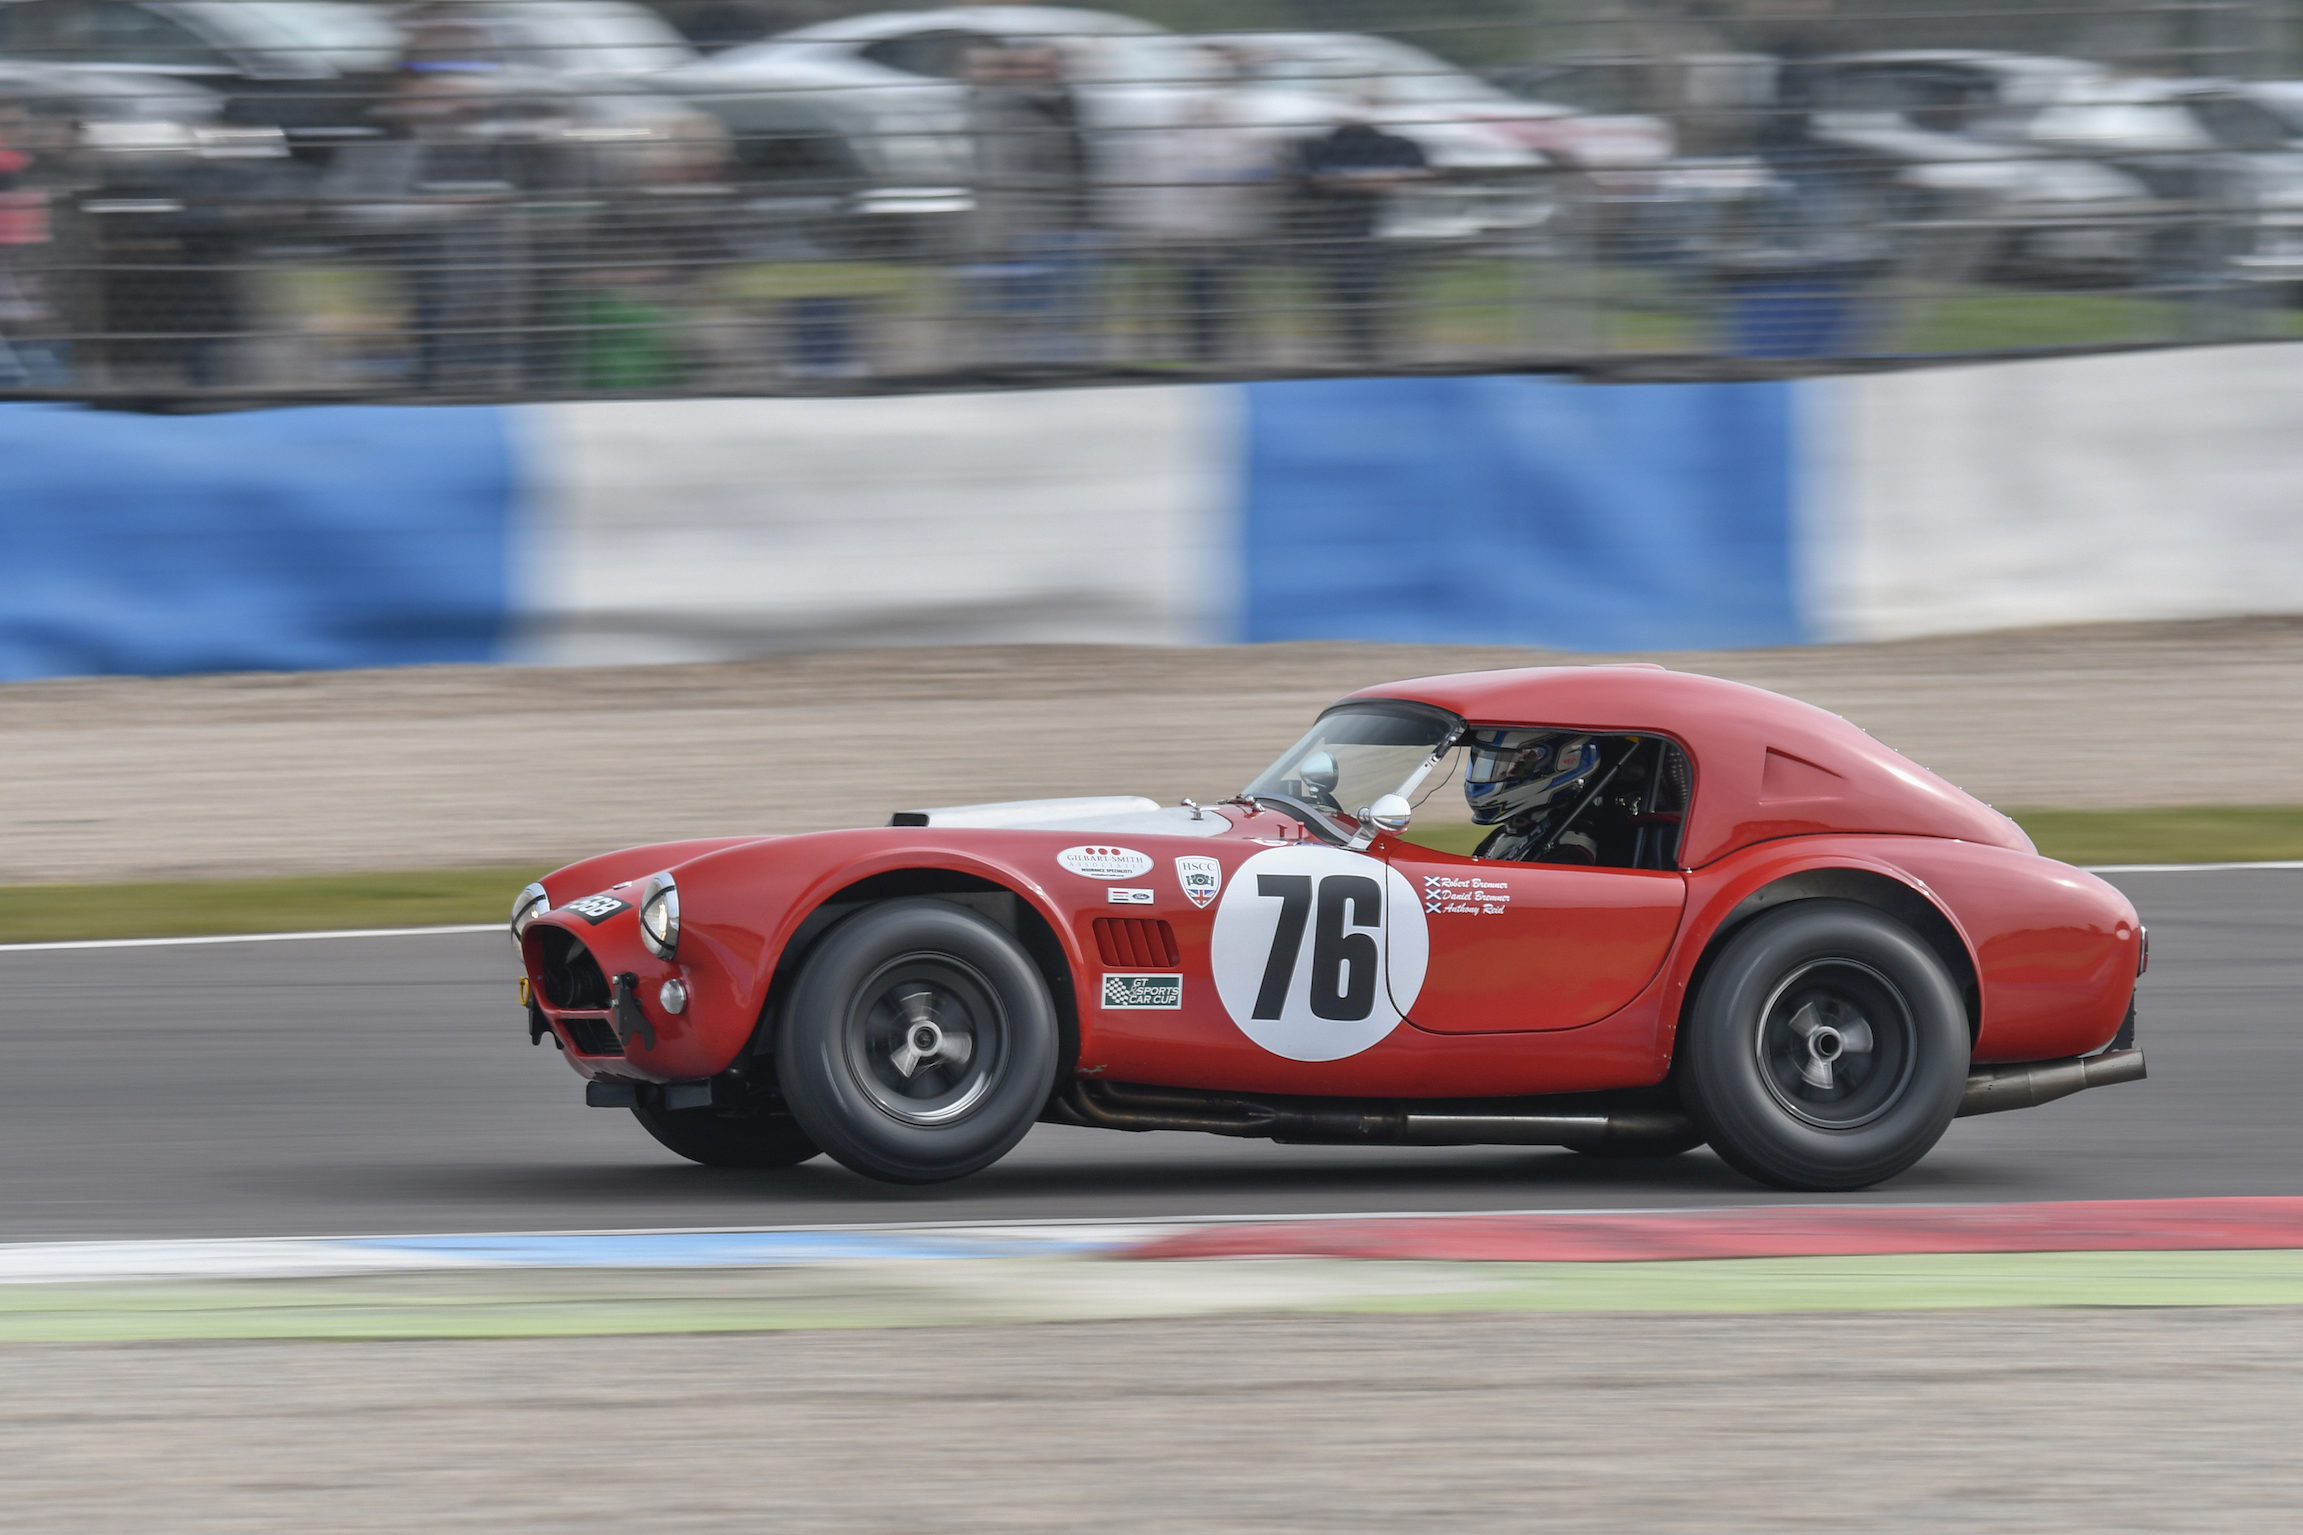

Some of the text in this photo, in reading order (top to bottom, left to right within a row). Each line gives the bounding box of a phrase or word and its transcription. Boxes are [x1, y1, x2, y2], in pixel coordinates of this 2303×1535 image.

[1067, 854, 1144, 863] GILBART-SMITH
[1182, 862, 1215, 871] HSCC
[1441, 877, 1470, 888] Robert
[1441, 889, 1472, 901] Daniel
[1443, 903, 1505, 916] Anthony Reid
[1251, 874, 1382, 1022] 76
[1133, 978, 1149, 987] GT
[1137, 987, 1180, 996] SPORTS
[1129, 995, 1177, 1004] CAR CUP
